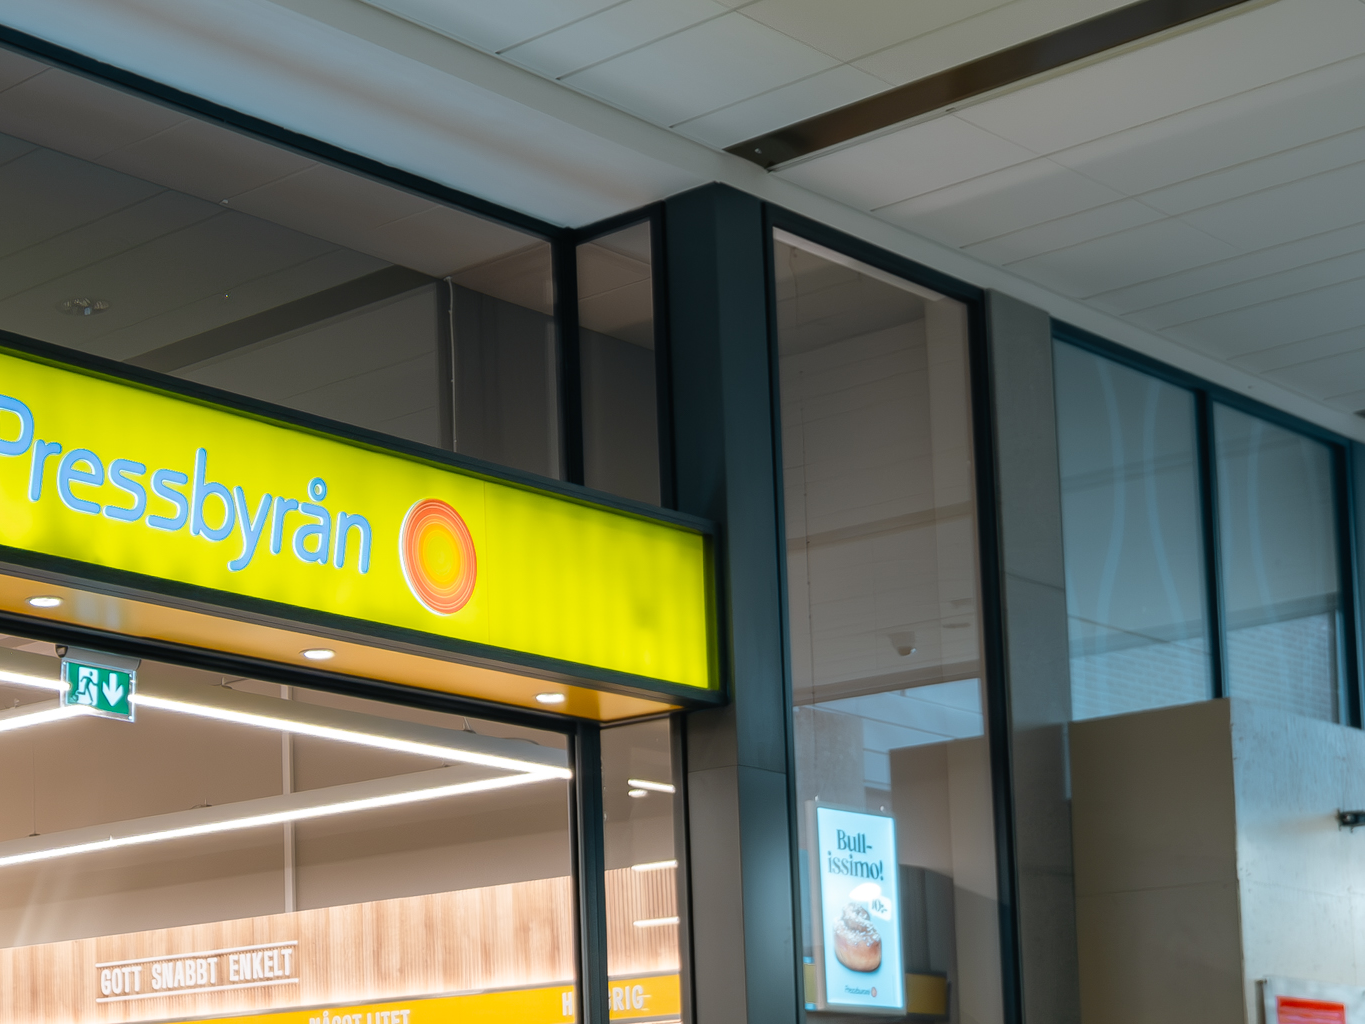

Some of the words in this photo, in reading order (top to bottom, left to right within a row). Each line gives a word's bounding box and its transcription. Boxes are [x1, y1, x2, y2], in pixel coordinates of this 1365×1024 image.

[836, 828, 873, 854] Bull-
[827, 851, 884, 881] issimo!
[100, 965, 142, 996] GOTT
[151, 957, 218, 991] SNABBT
[229, 948, 293, 982] ENKELT
[561, 984, 644, 1016] HRIG
